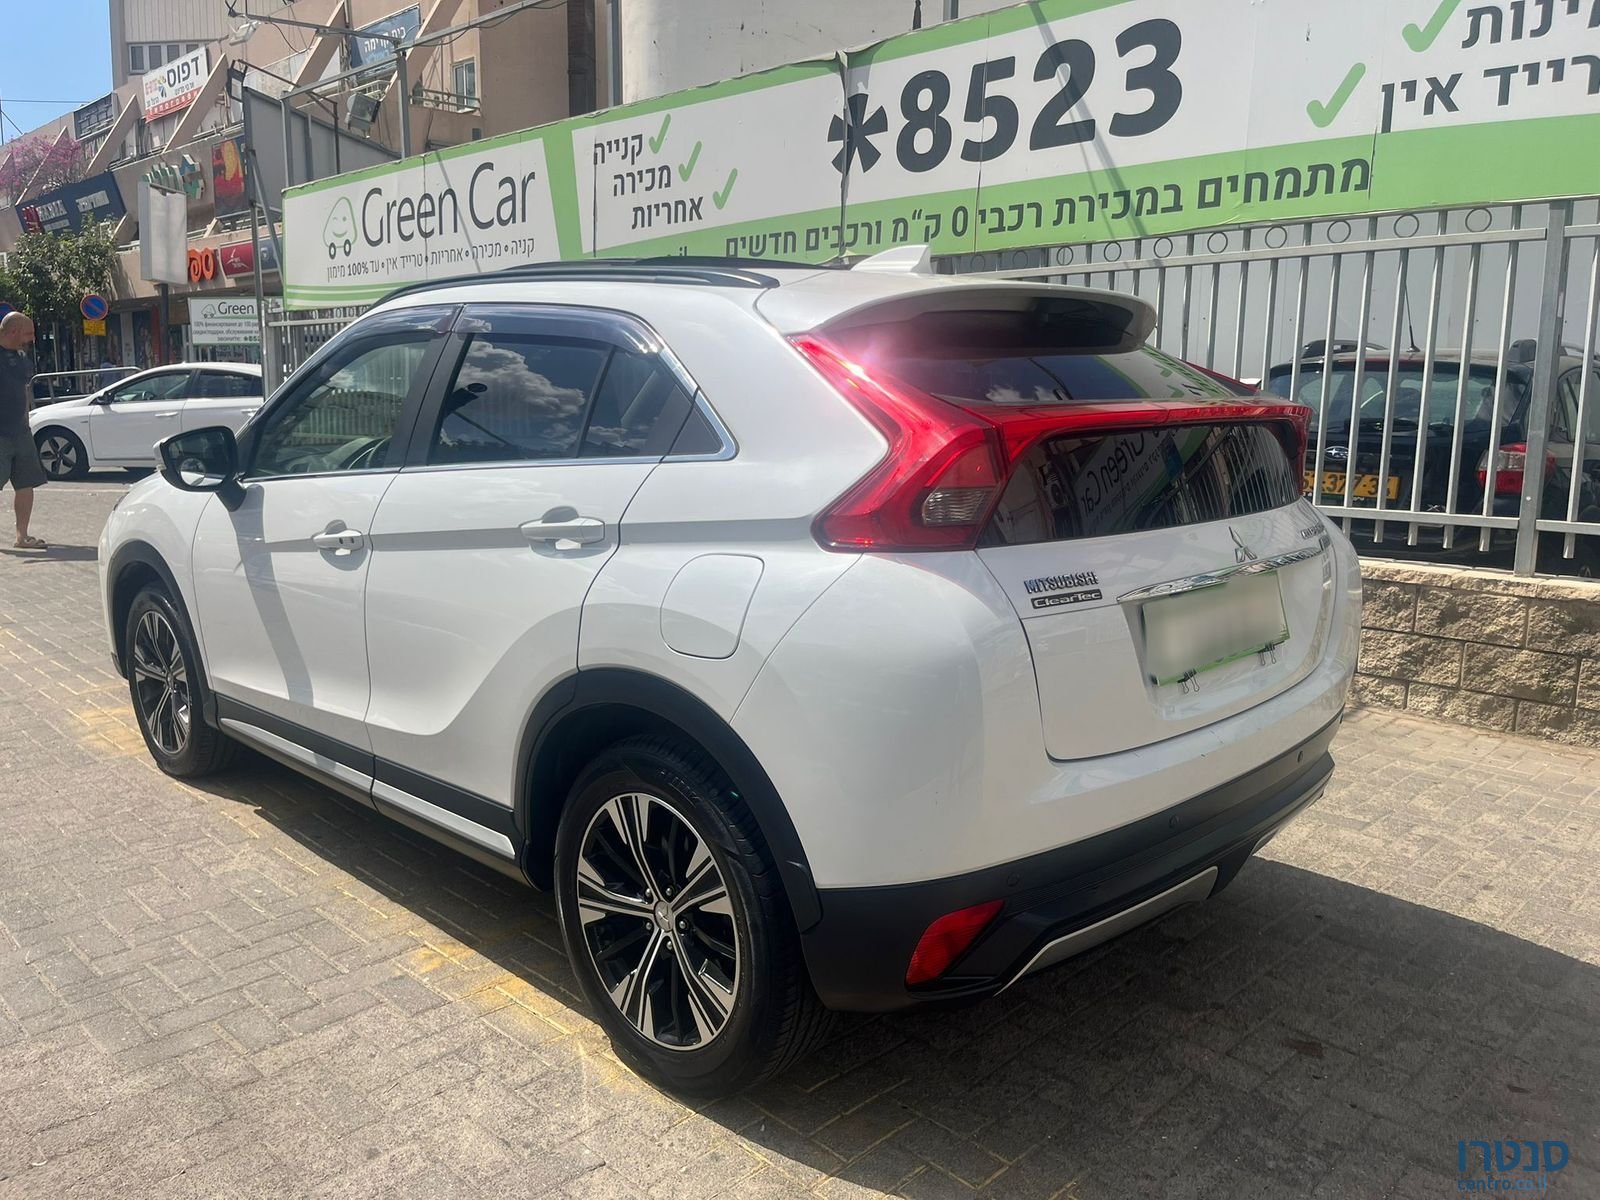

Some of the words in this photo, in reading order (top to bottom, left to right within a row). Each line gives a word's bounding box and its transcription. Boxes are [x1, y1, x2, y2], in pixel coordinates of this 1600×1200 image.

[1461, 0, 1600, 48] ינות
[167, 56, 199, 87] דפוס
[1381, 72, 1463, 133] אין
[593, 133, 643, 165] קנייה
[613, 164, 671, 197] מכירה
[1197, 158, 1370, 209] מתמחים
[362, 187, 459, 247] Green
[469, 161, 536, 230] Car
[631, 196, 704, 230] אחריות
[978, 202, 1042, 233] רכבי
[1052, 183, 1183, 226] במכירת
[805, 219, 883, 251] ורכבים
[951, 205, 969, 237] 0
[430, 247, 464, 265] אחריות
[471, 241, 502, 260] מכירה
[511, 237, 535, 259] קניה
[725, 230, 797, 258] חדשים
[327, 265, 346, 283] מימון
[347, 260, 369, 276] 100%
[369, 259, 380, 273] עד
[386, 256, 398, 275] אין
[399, 252, 423, 269] טרייד
[218, 301, 254, 315] Green
[1023, 571, 1099, 594] MITSUBISHI
[1032, 590, 1102, 608] ClearTec
